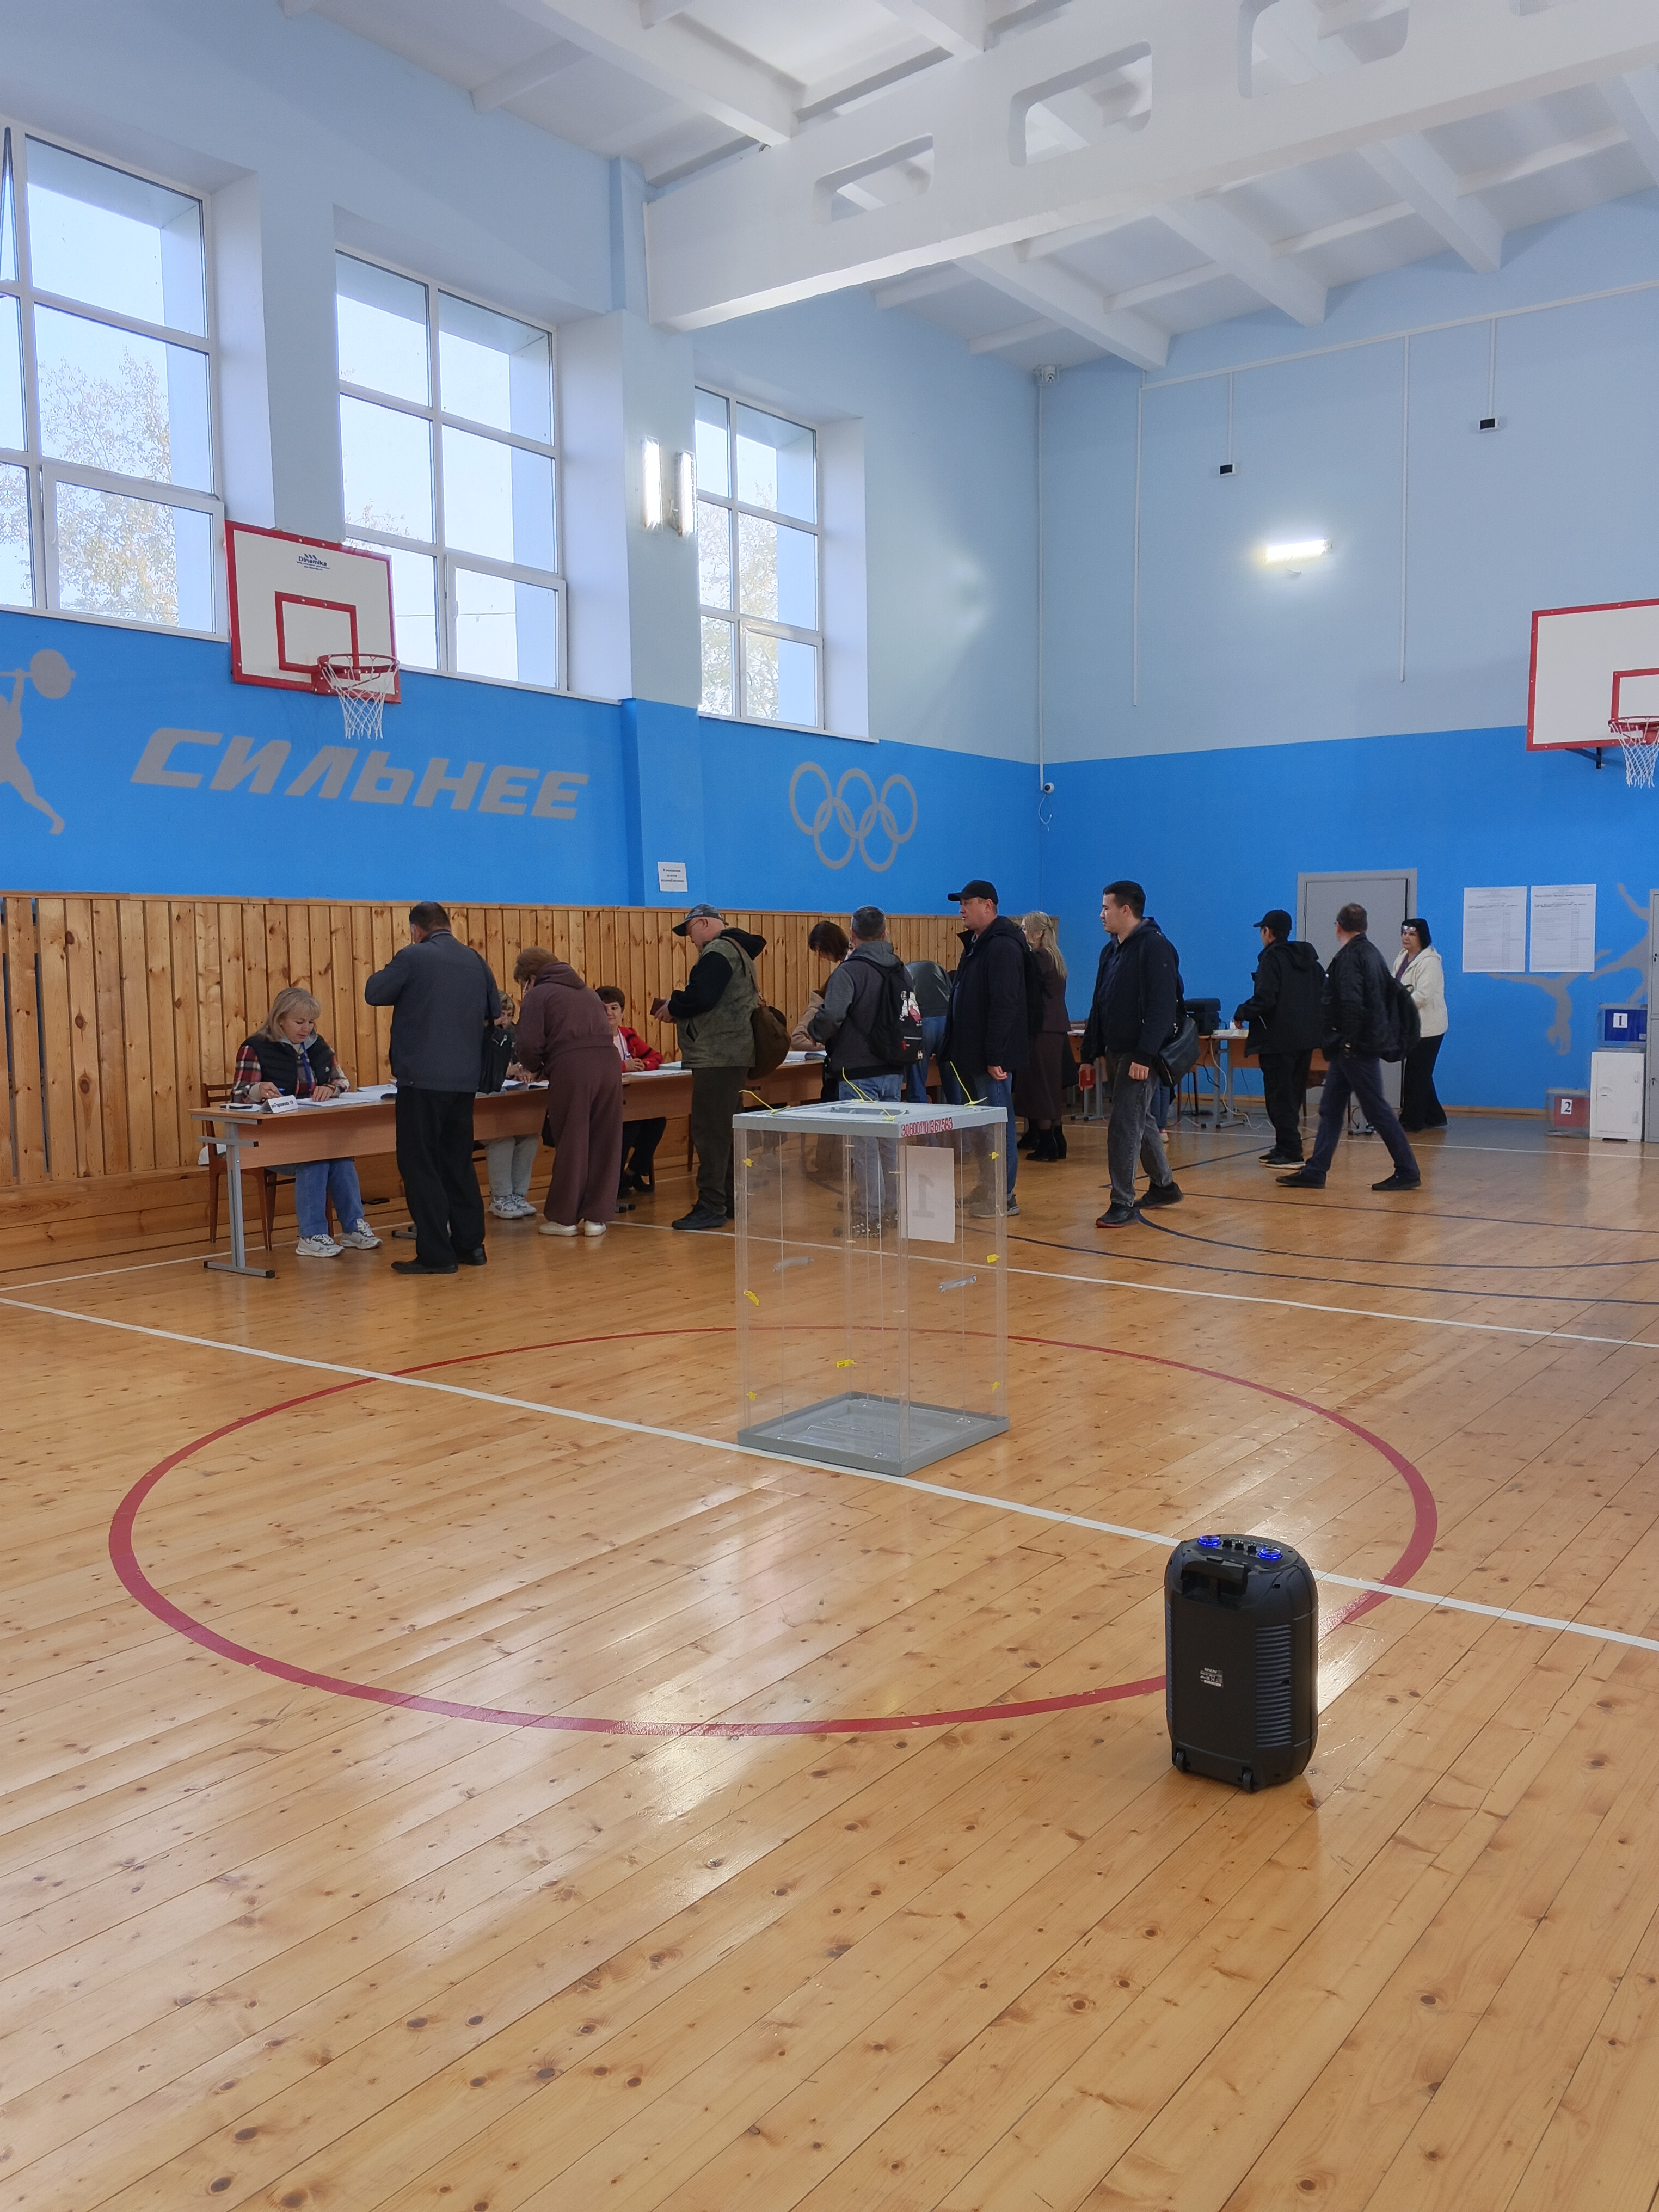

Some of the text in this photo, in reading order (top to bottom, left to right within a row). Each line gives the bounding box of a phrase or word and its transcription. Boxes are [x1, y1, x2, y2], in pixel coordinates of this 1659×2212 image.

[298, 556, 327, 566] Dinamika
[130, 727, 590, 820] СИЛЬНЕЕ
[1618, 1016, 1623, 1026] 1
[1563, 1101, 1571, 1113] 2
